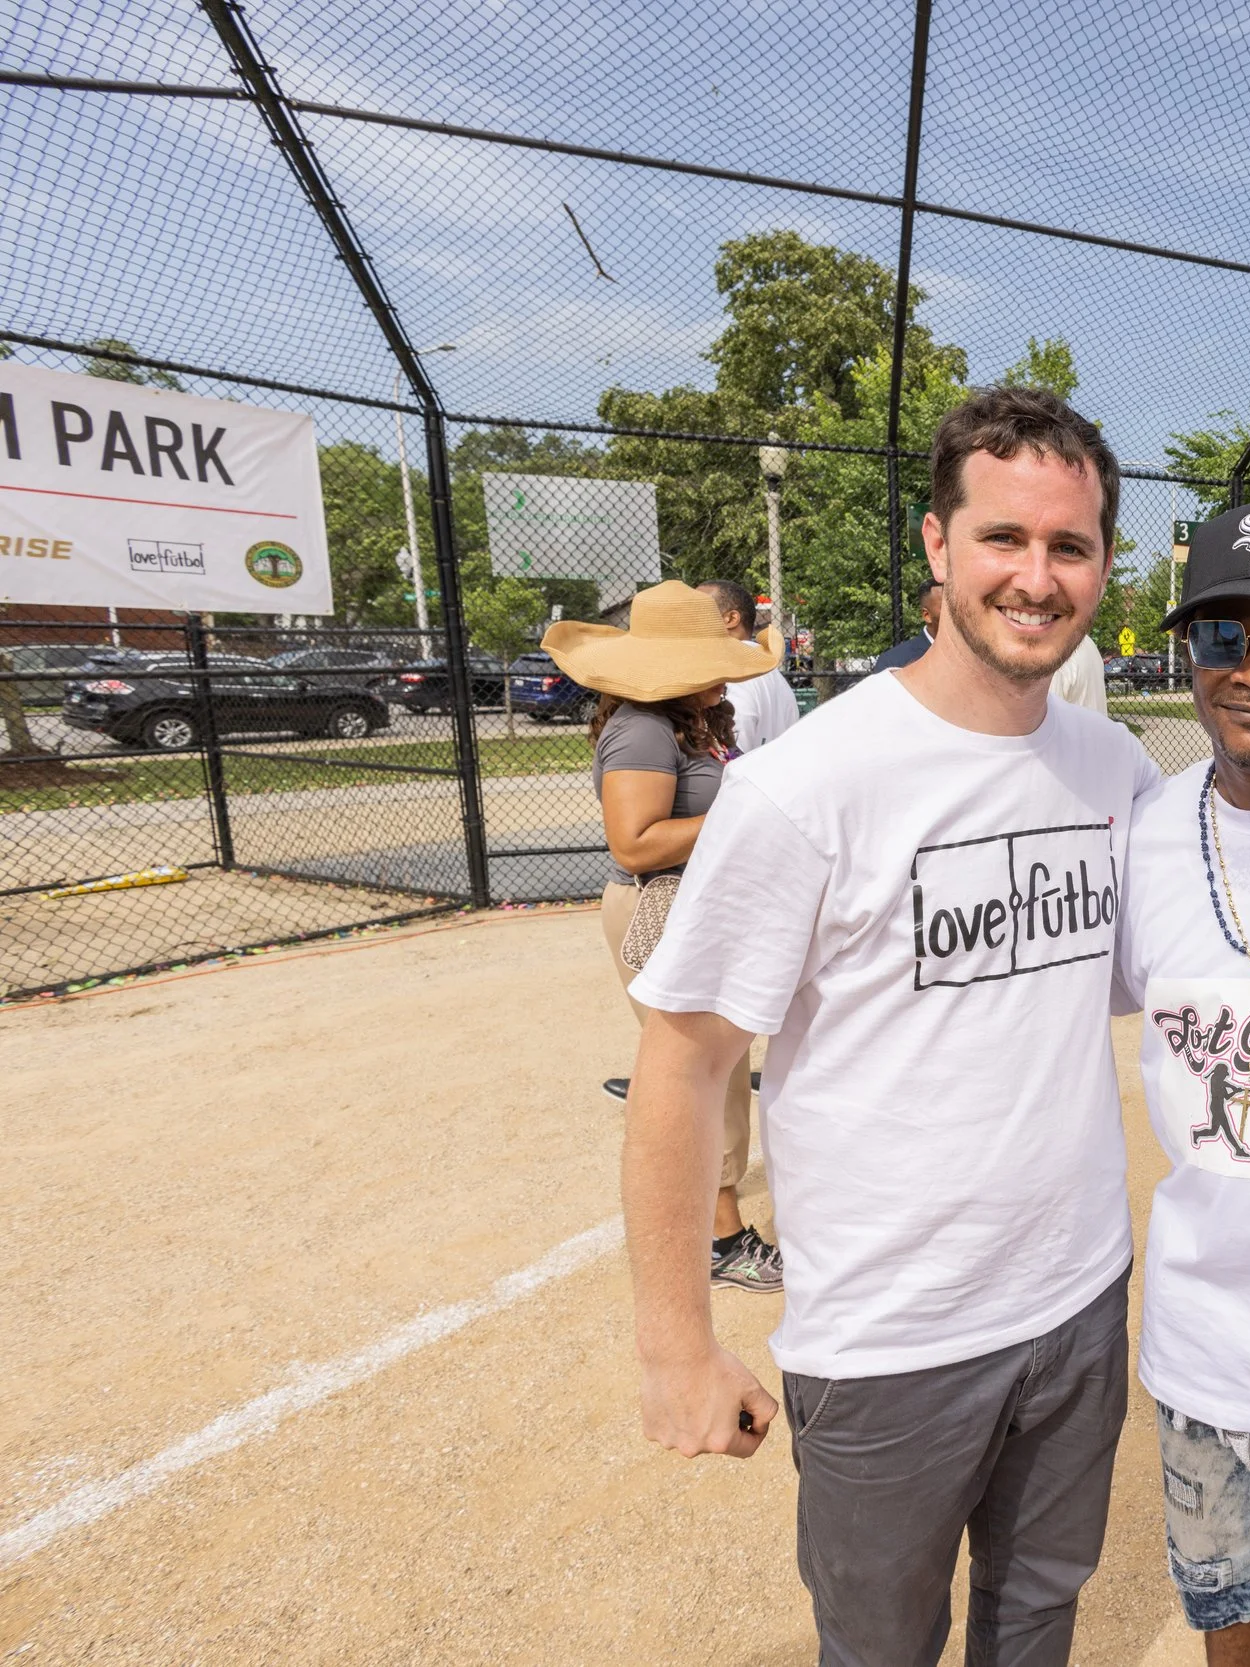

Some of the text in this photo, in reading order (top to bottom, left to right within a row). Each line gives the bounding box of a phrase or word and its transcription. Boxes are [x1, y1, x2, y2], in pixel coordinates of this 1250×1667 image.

[51, 400, 235, 486] PARK
[129, 546, 158, 565] love
[912, 884, 1006, 958] love
[1153, 1005, 1235, 1073] Lost
